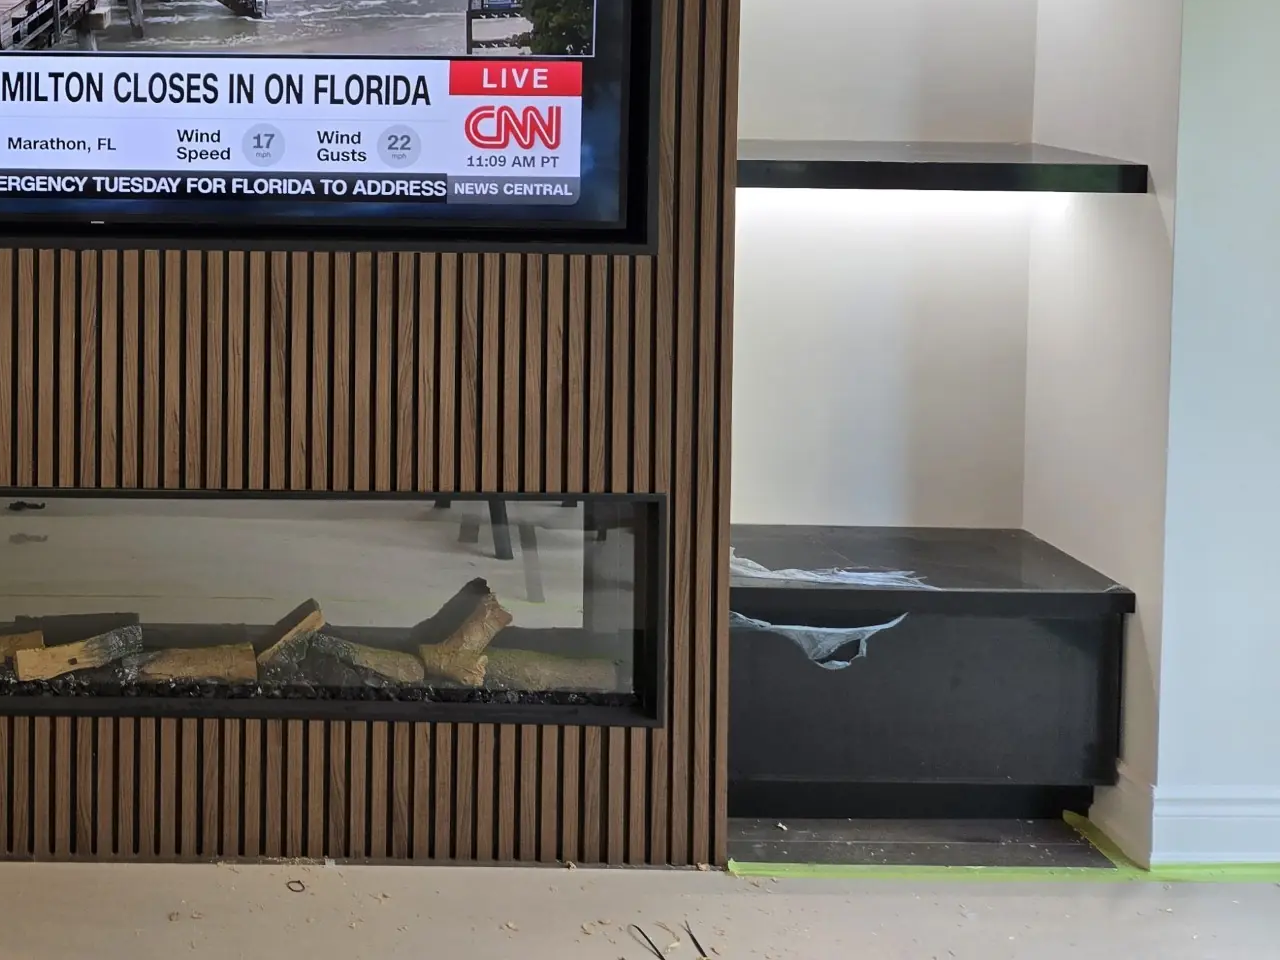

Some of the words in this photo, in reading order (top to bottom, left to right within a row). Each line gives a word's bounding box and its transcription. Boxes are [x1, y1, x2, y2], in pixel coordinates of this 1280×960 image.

[482, 68, 549, 89] LIVE
[1, 71, 104, 102] MILTON
[113, 72, 218, 104] CLOSES
[228, 73, 254, 104] IN
[264, 73, 305, 105] ON
[314, 74, 432, 106] FLORIDA
[464, 105, 562, 150] CNN
[7, 136, 92, 153] Marathon,
[97, 136, 116, 151] FL
[176, 129, 221, 144] Wind
[252, 133, 275, 150] 17
[317, 130, 361, 145] Wind
[387, 134, 411, 151] 22
[176, 146, 231, 163] Speed
[255, 151, 272, 159] mph
[317, 147, 367, 162] Gusts
[467, 155, 506, 168] 11:09
[512, 155, 535, 168] AM
[540, 155, 560, 168] PT
[92, 176, 181, 193] TUESDAY
[186, 177, 226, 194] FOR
[231, 178, 315, 195] FLORIDA
[320, 179, 347, 195] TO
[352, 179, 447, 197] ADDRESS
[454, 182, 497, 194] NEWS
[503, 182, 573, 196] CENTRAL
